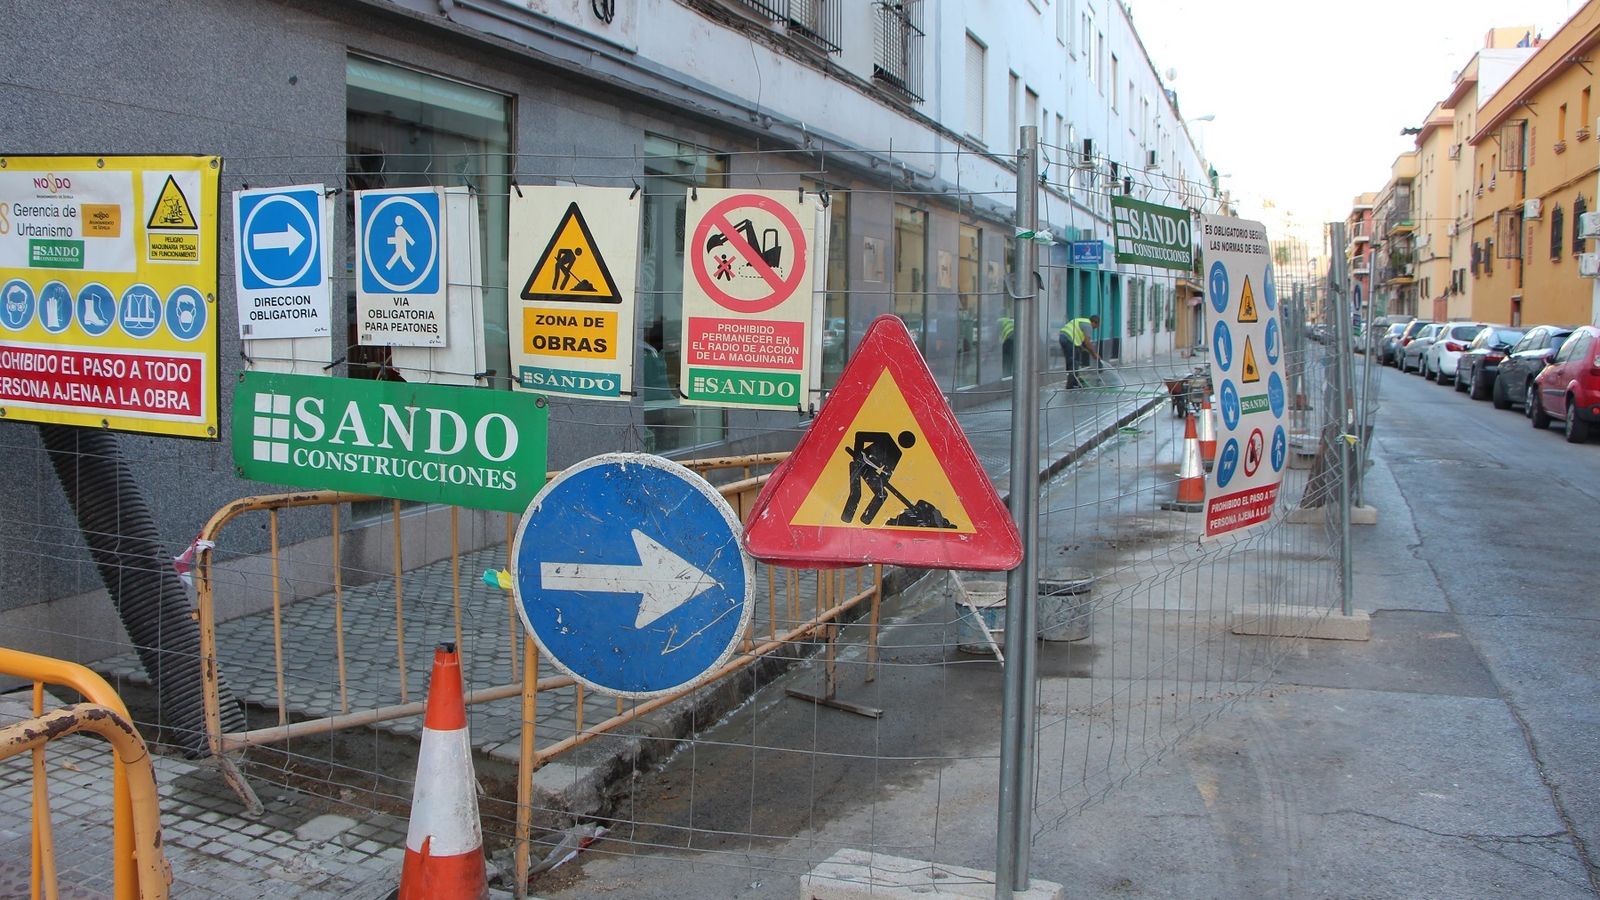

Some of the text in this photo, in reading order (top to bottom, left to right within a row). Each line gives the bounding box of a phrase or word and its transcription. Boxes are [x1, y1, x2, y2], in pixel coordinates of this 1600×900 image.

[13, 203, 77, 218] Gerencia de
[17, 222, 73, 238] Urbanismo
[1129, 208, 1190, 248] SANDO
[1205, 224, 1213, 235] ES
[1213, 226, 1248, 239] OBLIGATORIO
[164, 236, 184, 244] PELIGRO
[1210, 240, 1221, 251] LAS
[1221, 241, 1244, 254] NORMAS
[1244, 244, 1252, 254] DE
[40, 245, 80, 257] SANDO
[160, 251, 198, 259] FUNCIONAMIENTO
[1134, 243, 1190, 264] CONSTRUCCIONES
[254, 295, 311, 308] DIRECCION
[393, 297, 410, 307] VIA
[249, 308, 319, 321] OBLIGATORIA
[368, 309, 436, 320] OBLIGATORIA
[535, 314, 605, 328] ZONA DE
[365, 321, 439, 334] PARA PEATONES
[717, 323, 775, 335] PROHIBIDO
[532, 335, 608, 353] OBRAS
[702, 332, 791, 345] PERMANECER EN
[692, 341, 800, 355] EL RADIO DE ACCIÓN
[696, 351, 796, 364] DE LA MAQUINARIA
[0, 351, 192, 383] OHIBIDO EL PASO A TODO
[533, 372, 615, 391] SANDO
[705, 377, 796, 398] SANDO
[52, 381, 103, 404] AJENA
[105, 386, 117, 405] A
[120, 387, 142, 407] LA
[144, 388, 191, 411] OBRA
[1245, 398, 1268, 410] SANDO
[292, 396, 520, 462] SANDO
[293, 447, 518, 491] CONSTRUCCIONES
[1211, 498, 1242, 513] PROHIBIDO
[1242, 495, 1249, 506] EL
[1249, 491, 1264, 504] PASO
[1264, 490, 1269, 501] A
[1210, 514, 1236, 529] PERSONA
[1237, 509, 1255, 523] AJENA
[1255, 507, 1260, 518] A
[1260, 504, 1267, 516] LA
